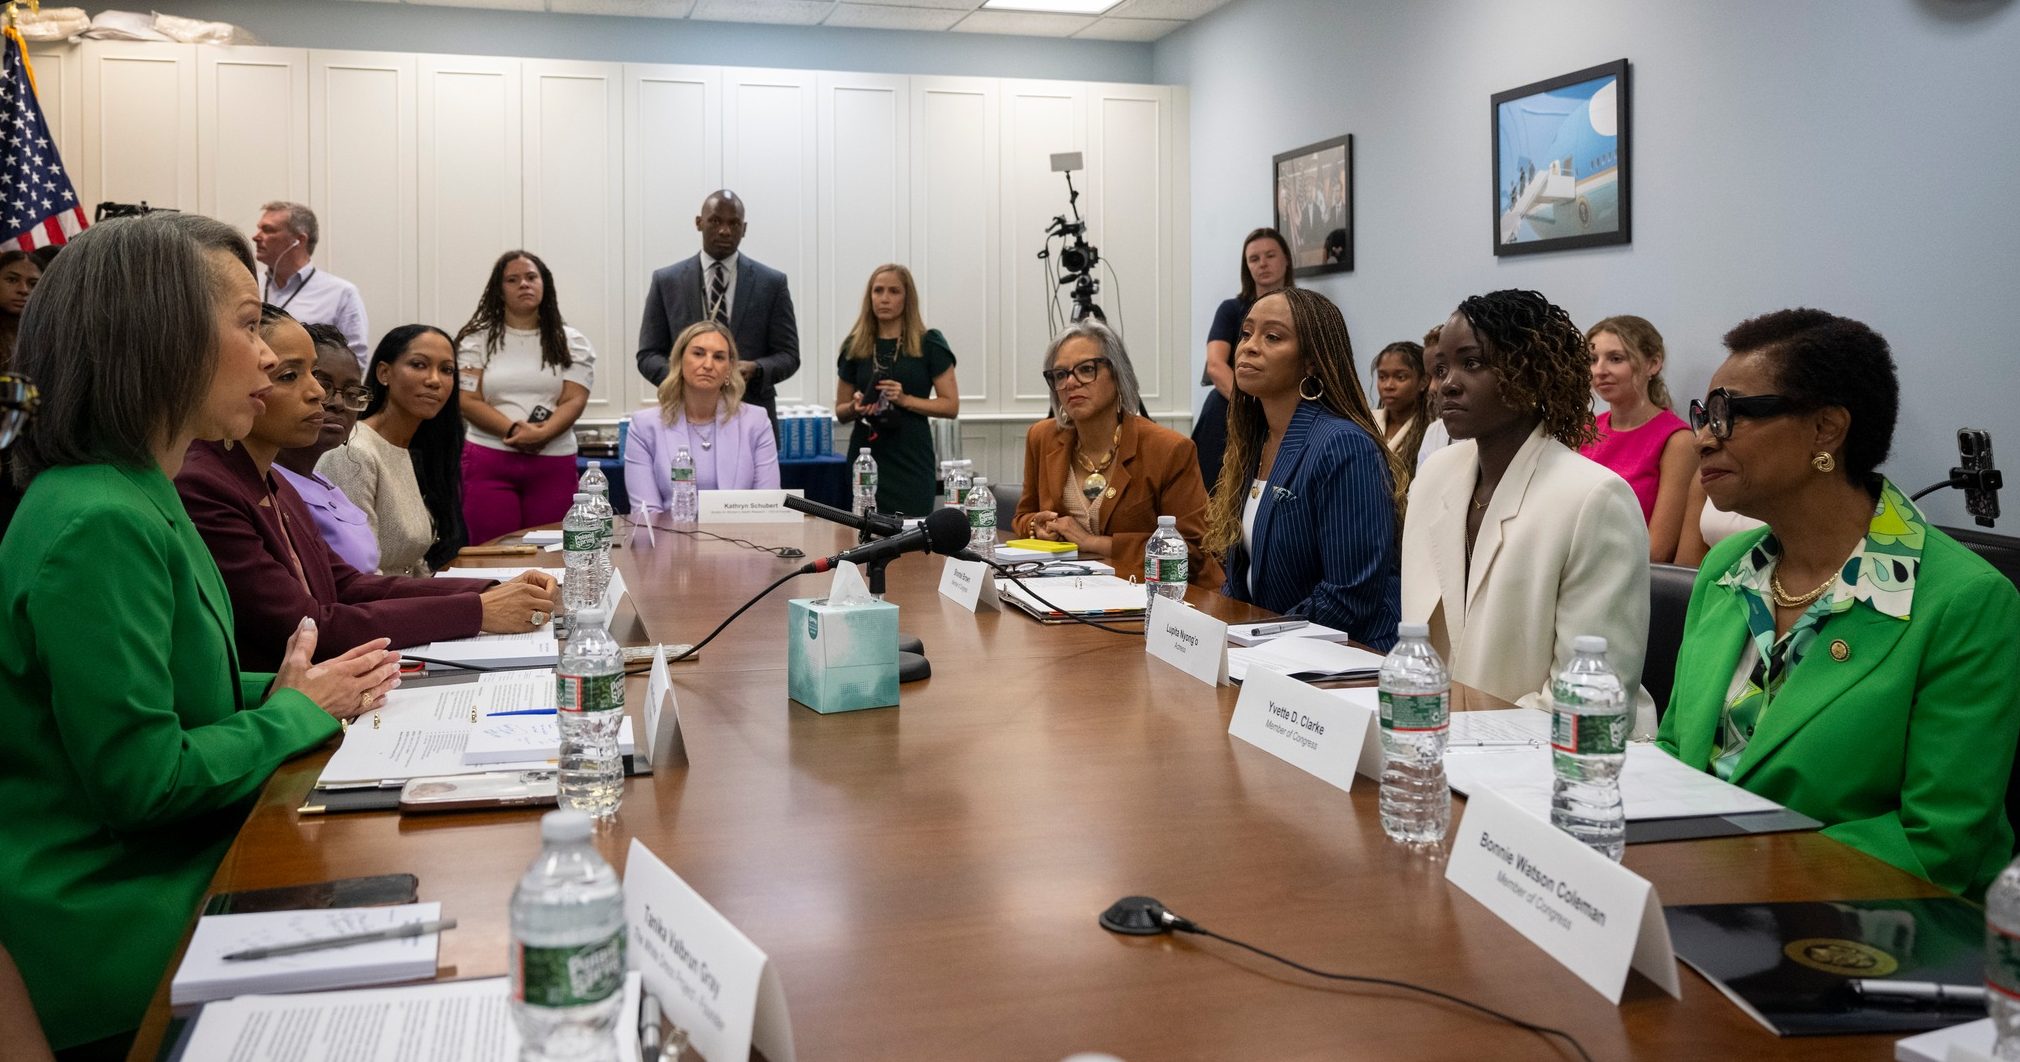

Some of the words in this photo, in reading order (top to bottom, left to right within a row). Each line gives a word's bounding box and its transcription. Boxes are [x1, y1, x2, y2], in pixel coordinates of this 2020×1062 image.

[1166, 624, 1180, 637] Lupita
[1180, 629, 1199, 646] Nyong'o
[1265, 719, 1286, 735] Member
[1286, 730, 1293, 738] of
[1292, 731, 1318, 750] Congress
[1268, 701, 1290, 720] Yvette
[1291, 711, 1299, 724] D.
[1300, 715, 1325, 736] Clarke
[1479, 831, 1514, 865] Bonnie
[1515, 853, 1555, 893] Watson
[1556, 881, 1607, 927] Coleman
[1496, 870, 1527, 899] Member
[1526, 893, 1537, 904] of
[1535, 896, 1572, 931] Congress
